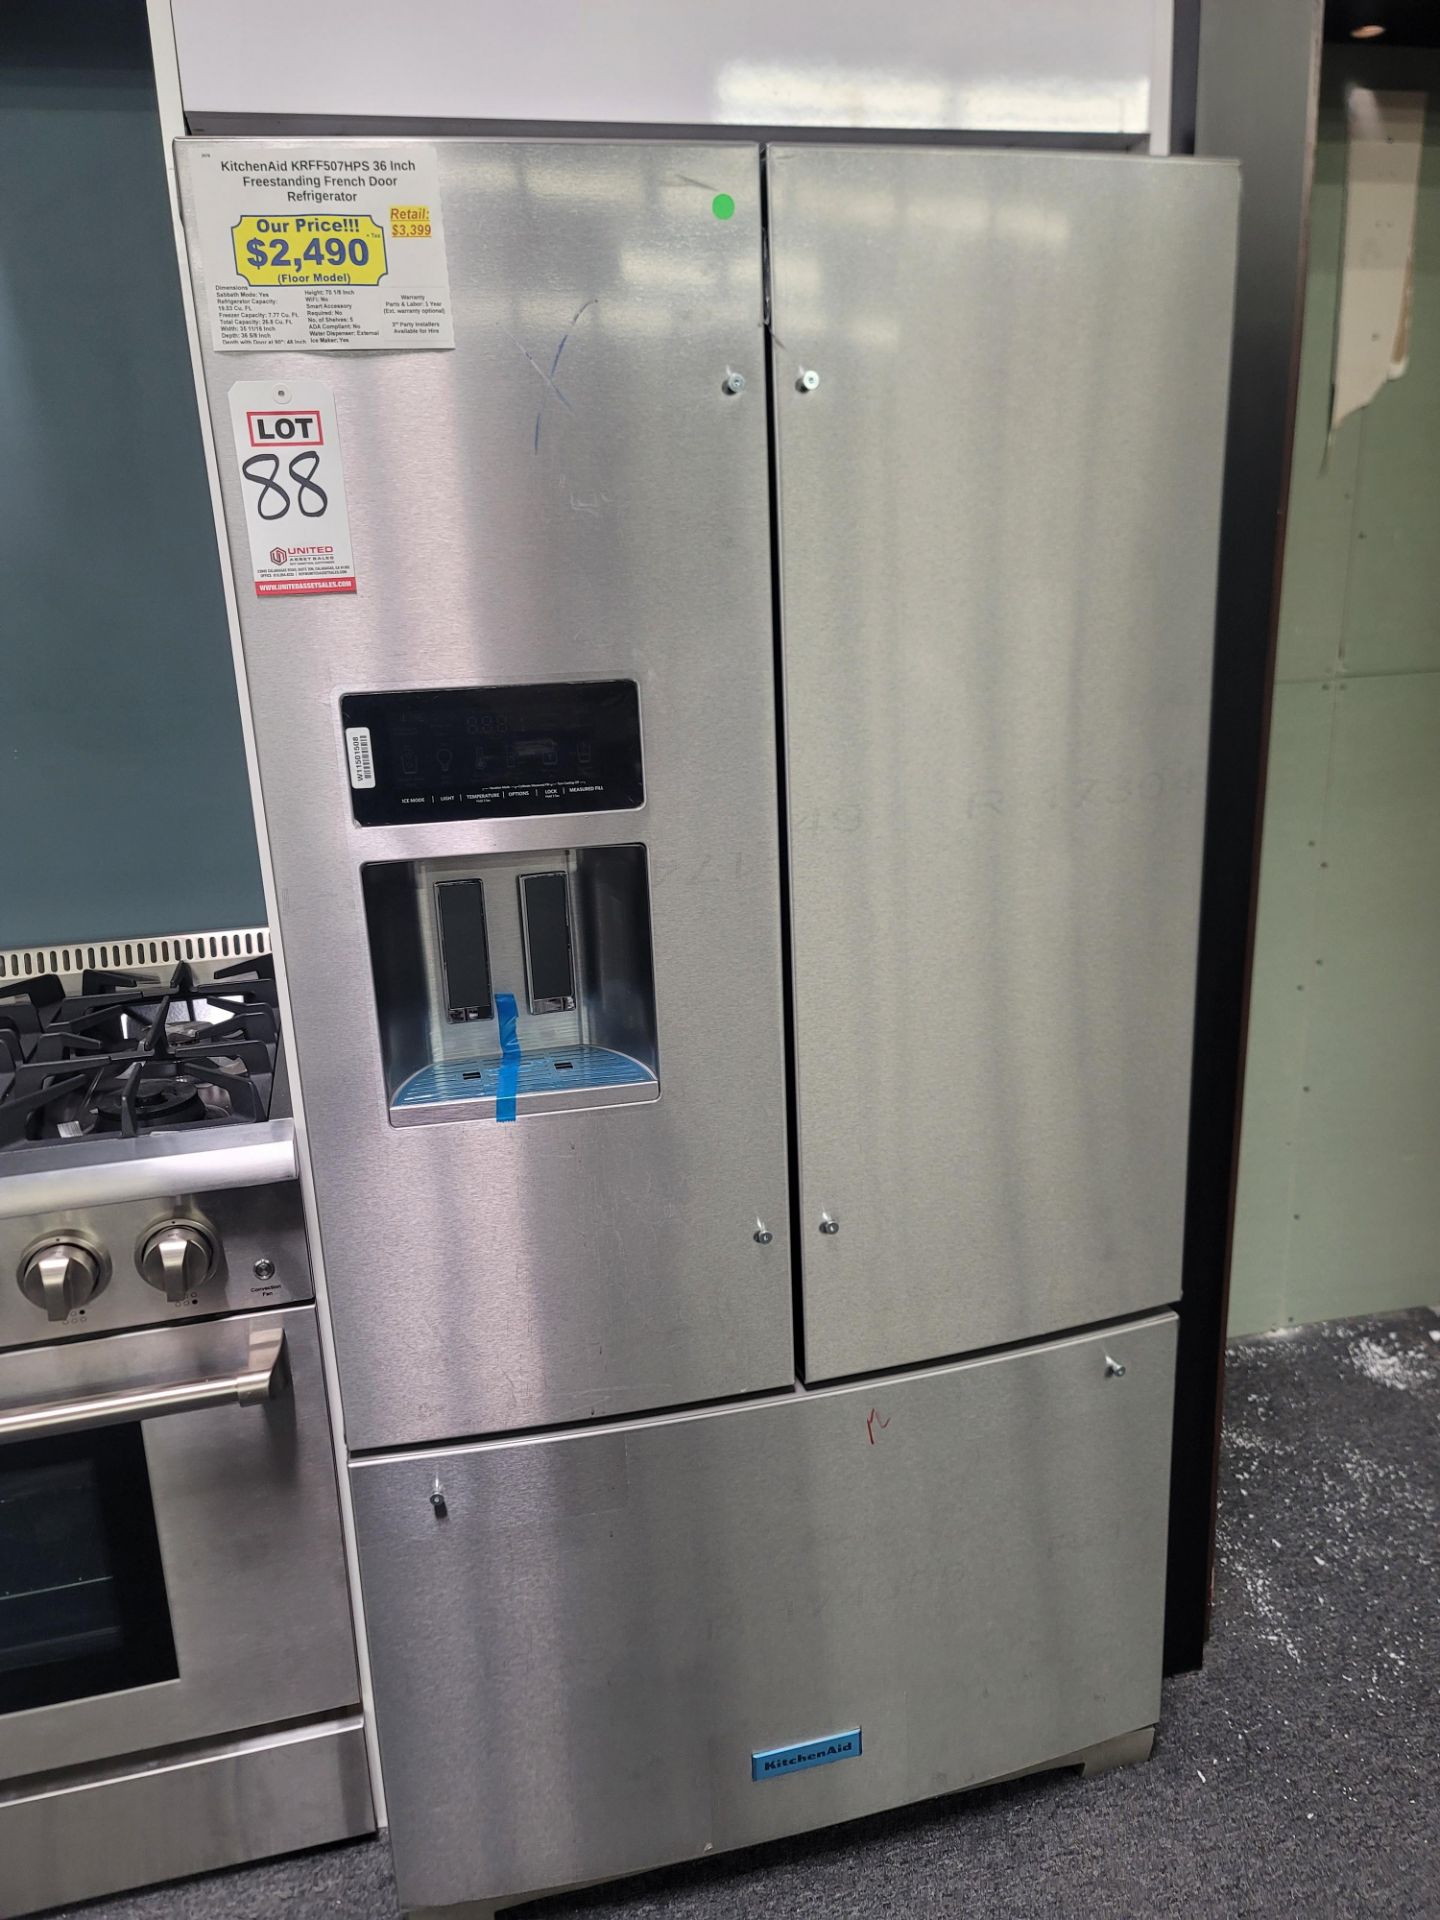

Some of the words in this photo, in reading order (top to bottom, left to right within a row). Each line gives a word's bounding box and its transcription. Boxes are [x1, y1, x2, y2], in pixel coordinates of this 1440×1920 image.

[221, 161, 288, 172] KitchenAid
[291, 160, 370, 171] KRFF507HPS
[373, 161, 387, 171] 36
[390, 160, 416, 171] Inch
[243, 176, 321, 188] Freestanding
[324, 176, 366, 187] French
[369, 176, 398, 187] Door
[287, 190, 357, 203] Refrigerator
[390, 208, 430, 220] Retail:
[257, 218, 289, 233] Our
[296, 218, 360, 233] Price!!!
[392, 224, 432, 237] $3,399
[246, 237, 369, 272] $2,490
[278, 274, 309, 286] (Floor
[313, 273, 351, 285] Model)
[257, 418, 313, 440] LOT
[242, 451, 328, 521] 88
[287, 546, 334, 555] UNITED
[259, 581, 352, 591] WWW.UNITEDASSETSALES.COM
[352, 736, 363, 782] W11501508
[764, 1742, 852, 1771] KitchenAid
